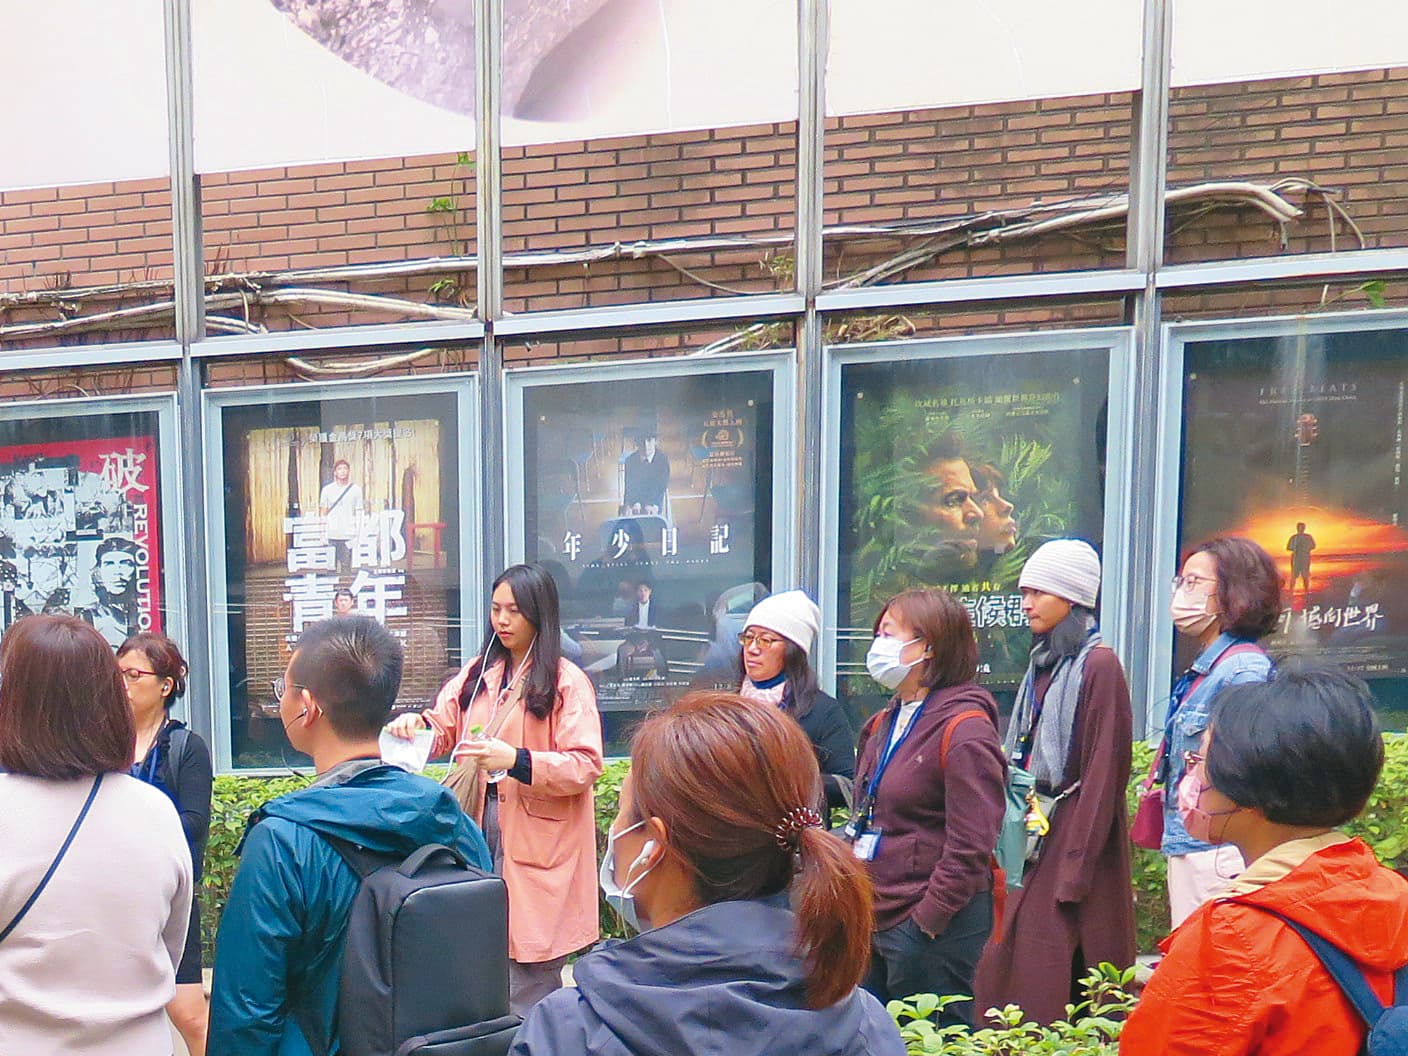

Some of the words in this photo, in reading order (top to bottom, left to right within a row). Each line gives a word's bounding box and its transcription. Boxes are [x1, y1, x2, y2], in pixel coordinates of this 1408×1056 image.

[98, 448, 150, 493] 破
[134, 503, 152, 634] REVOLUTIO
[283, 507, 407, 573] 富都
[283, 570, 408, 632] 青年
